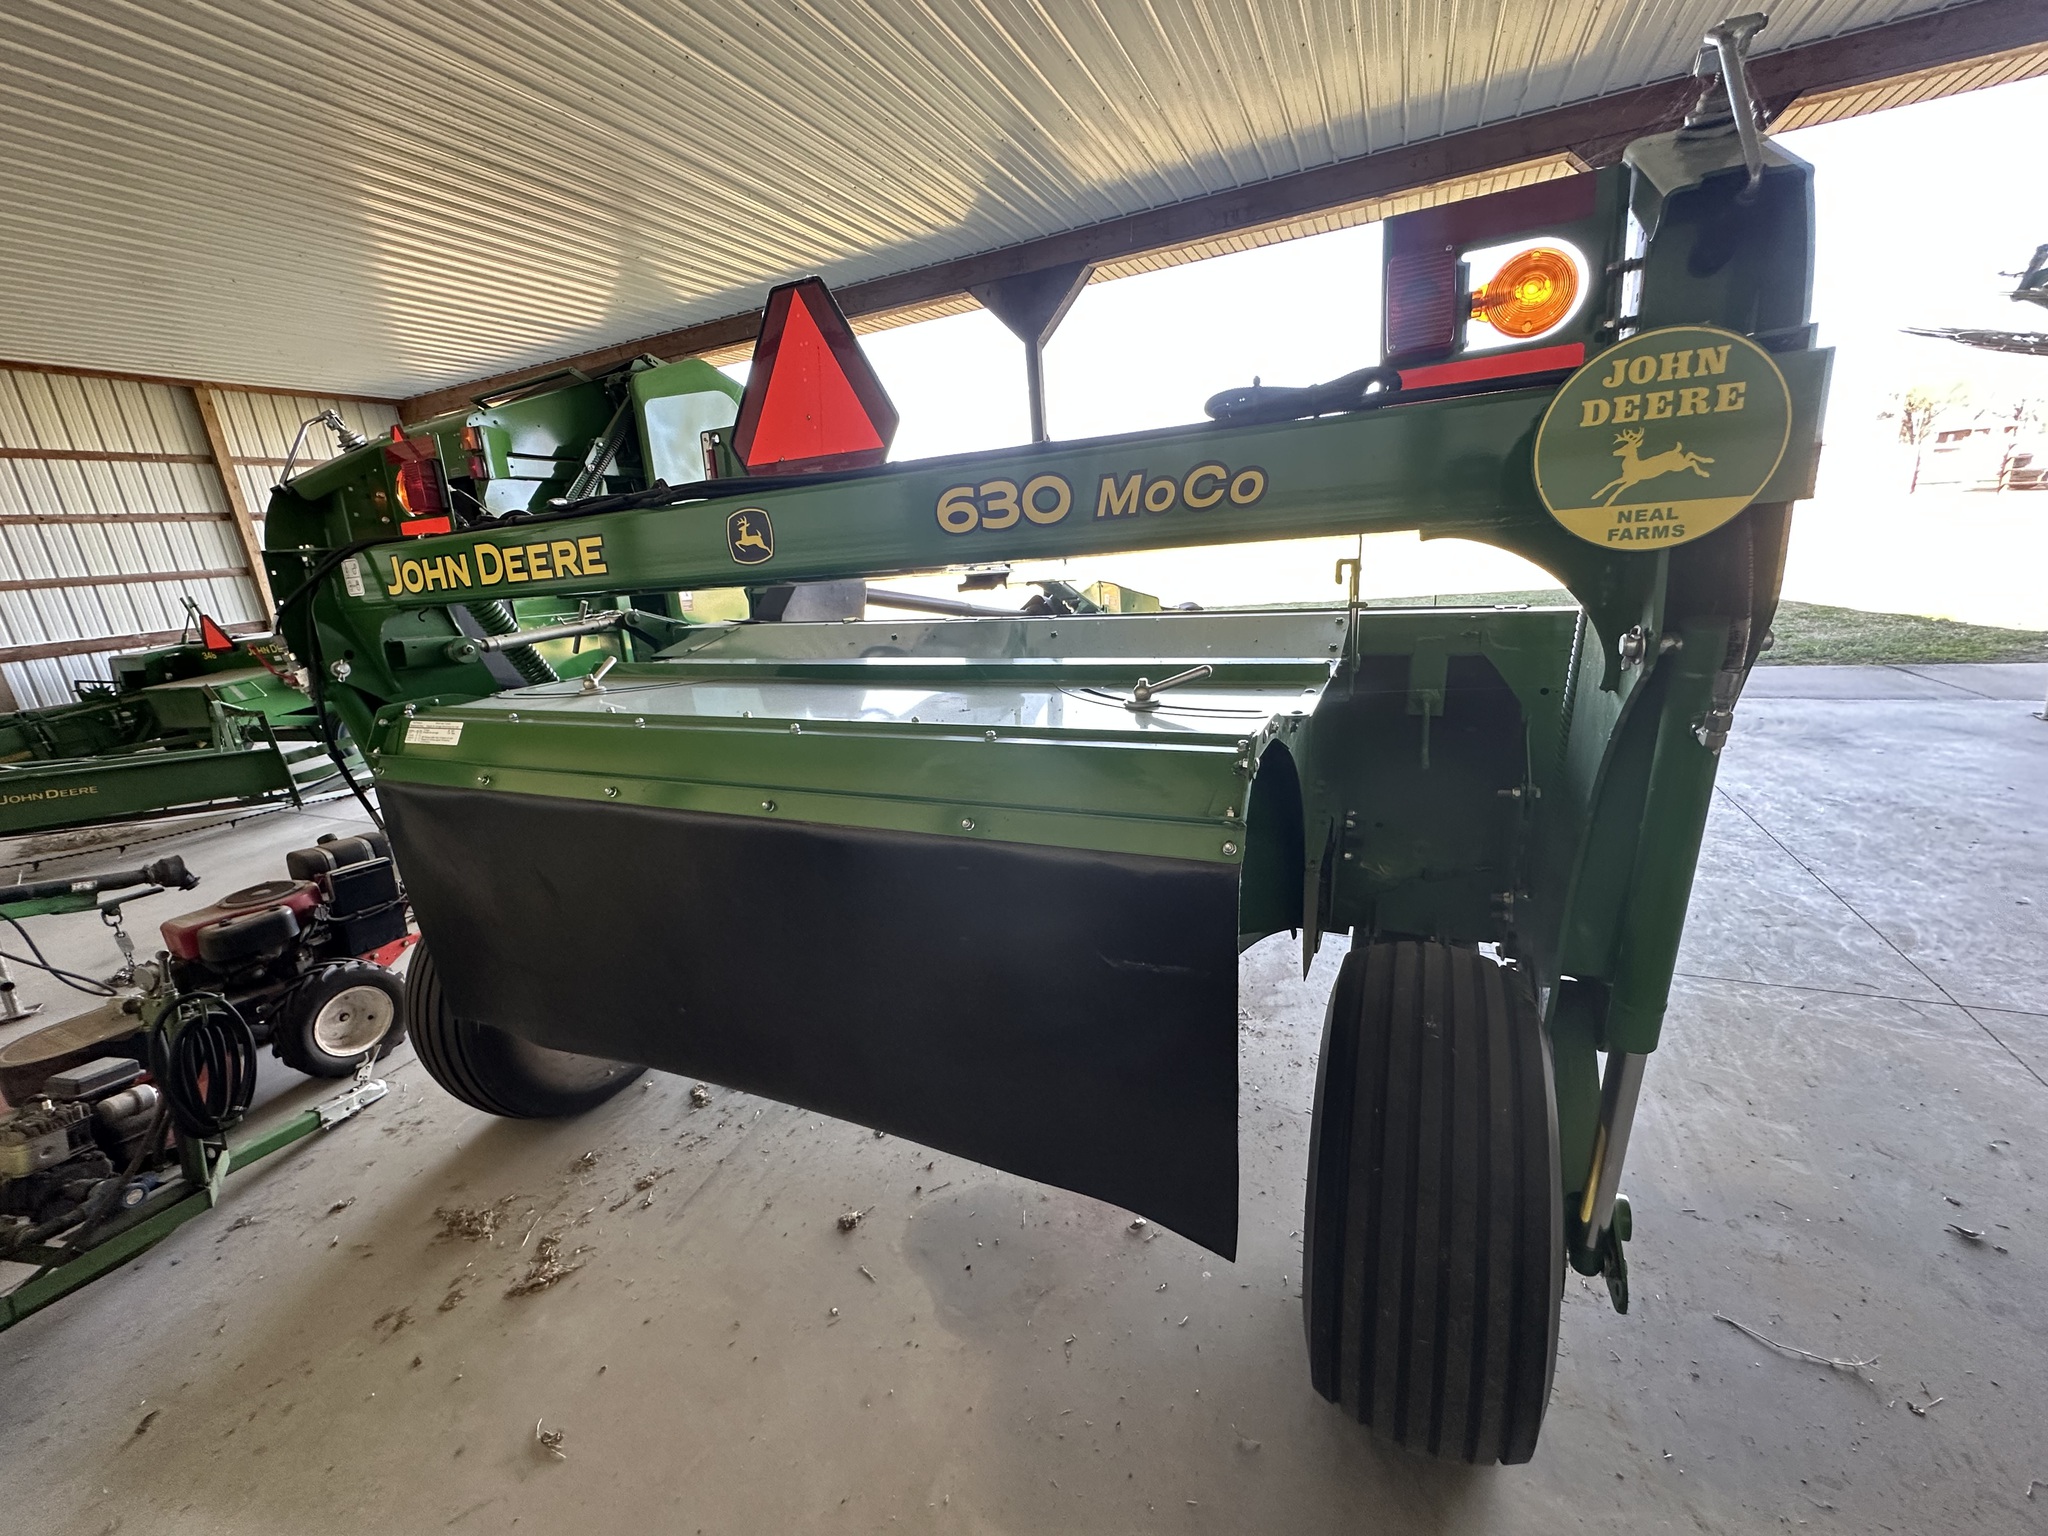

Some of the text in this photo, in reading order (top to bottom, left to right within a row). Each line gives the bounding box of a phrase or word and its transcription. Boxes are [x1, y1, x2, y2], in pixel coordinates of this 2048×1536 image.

[1602, 344, 1732, 389] JOHN
[1579, 381, 1747, 428] DEERE
[935, 473, 1073, 535] 630
[1616, 507, 1679, 524] NEAL
[1606, 524, 1685, 542] FARMS
[386, 552, 473, 597] JOHN
[472, 535, 608, 587] DEERE
[0, 785, 99, 806] JOHN DEERE
